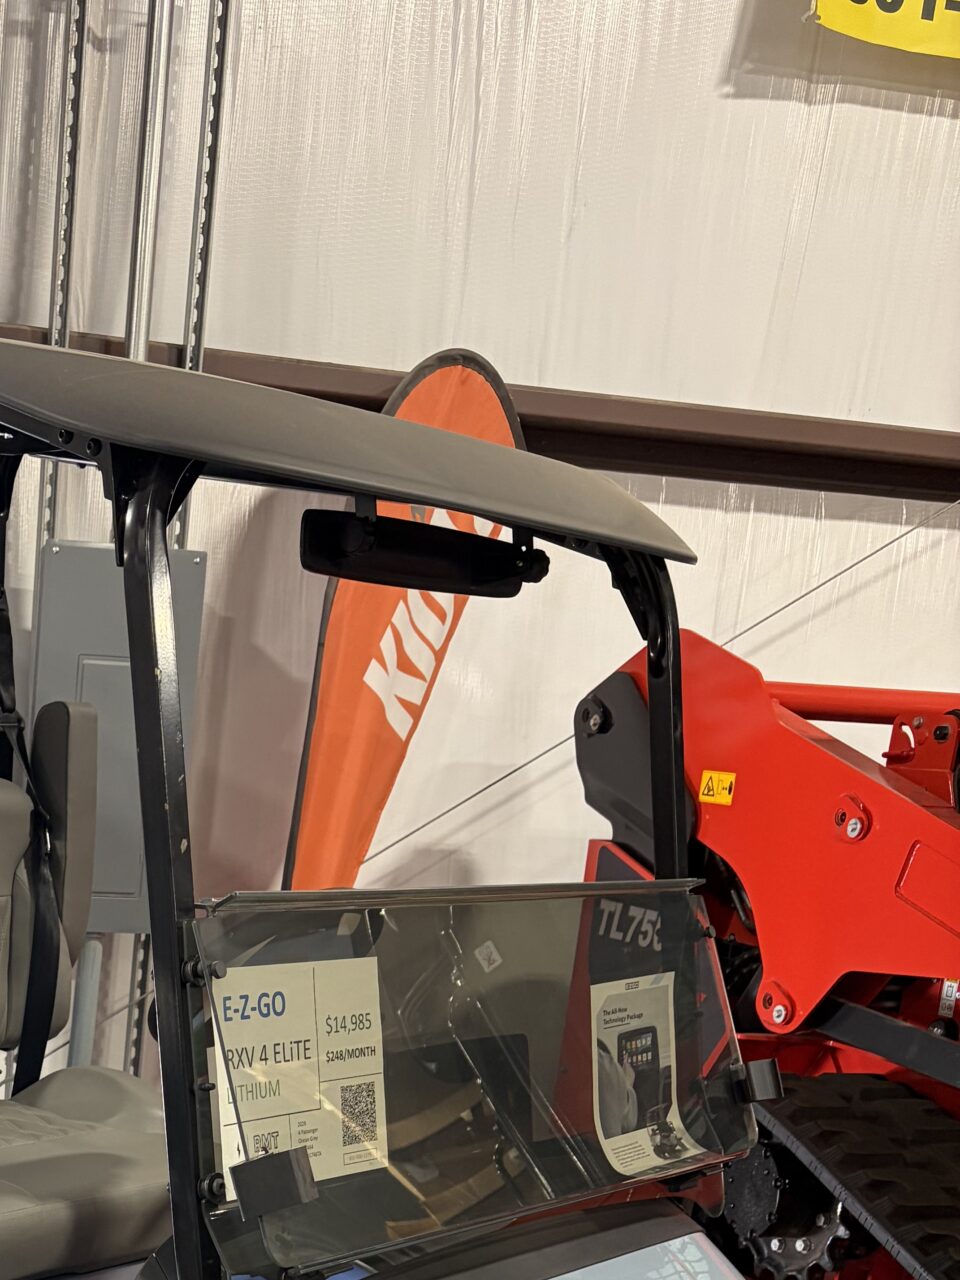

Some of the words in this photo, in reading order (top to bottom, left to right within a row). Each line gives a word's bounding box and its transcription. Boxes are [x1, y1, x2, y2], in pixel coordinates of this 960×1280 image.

[222, 991, 286, 1022] E-Z-GO
[325, 1013, 372, 1036] $14,985
[227, 1046, 255, 1070] RXV
[259, 1044, 269, 1066] 4
[273, 1039, 312, 1064] ELiTE
[326, 1046, 376, 1063] $248/MONTH
[227, 1079, 281, 1105] LITHIUM
